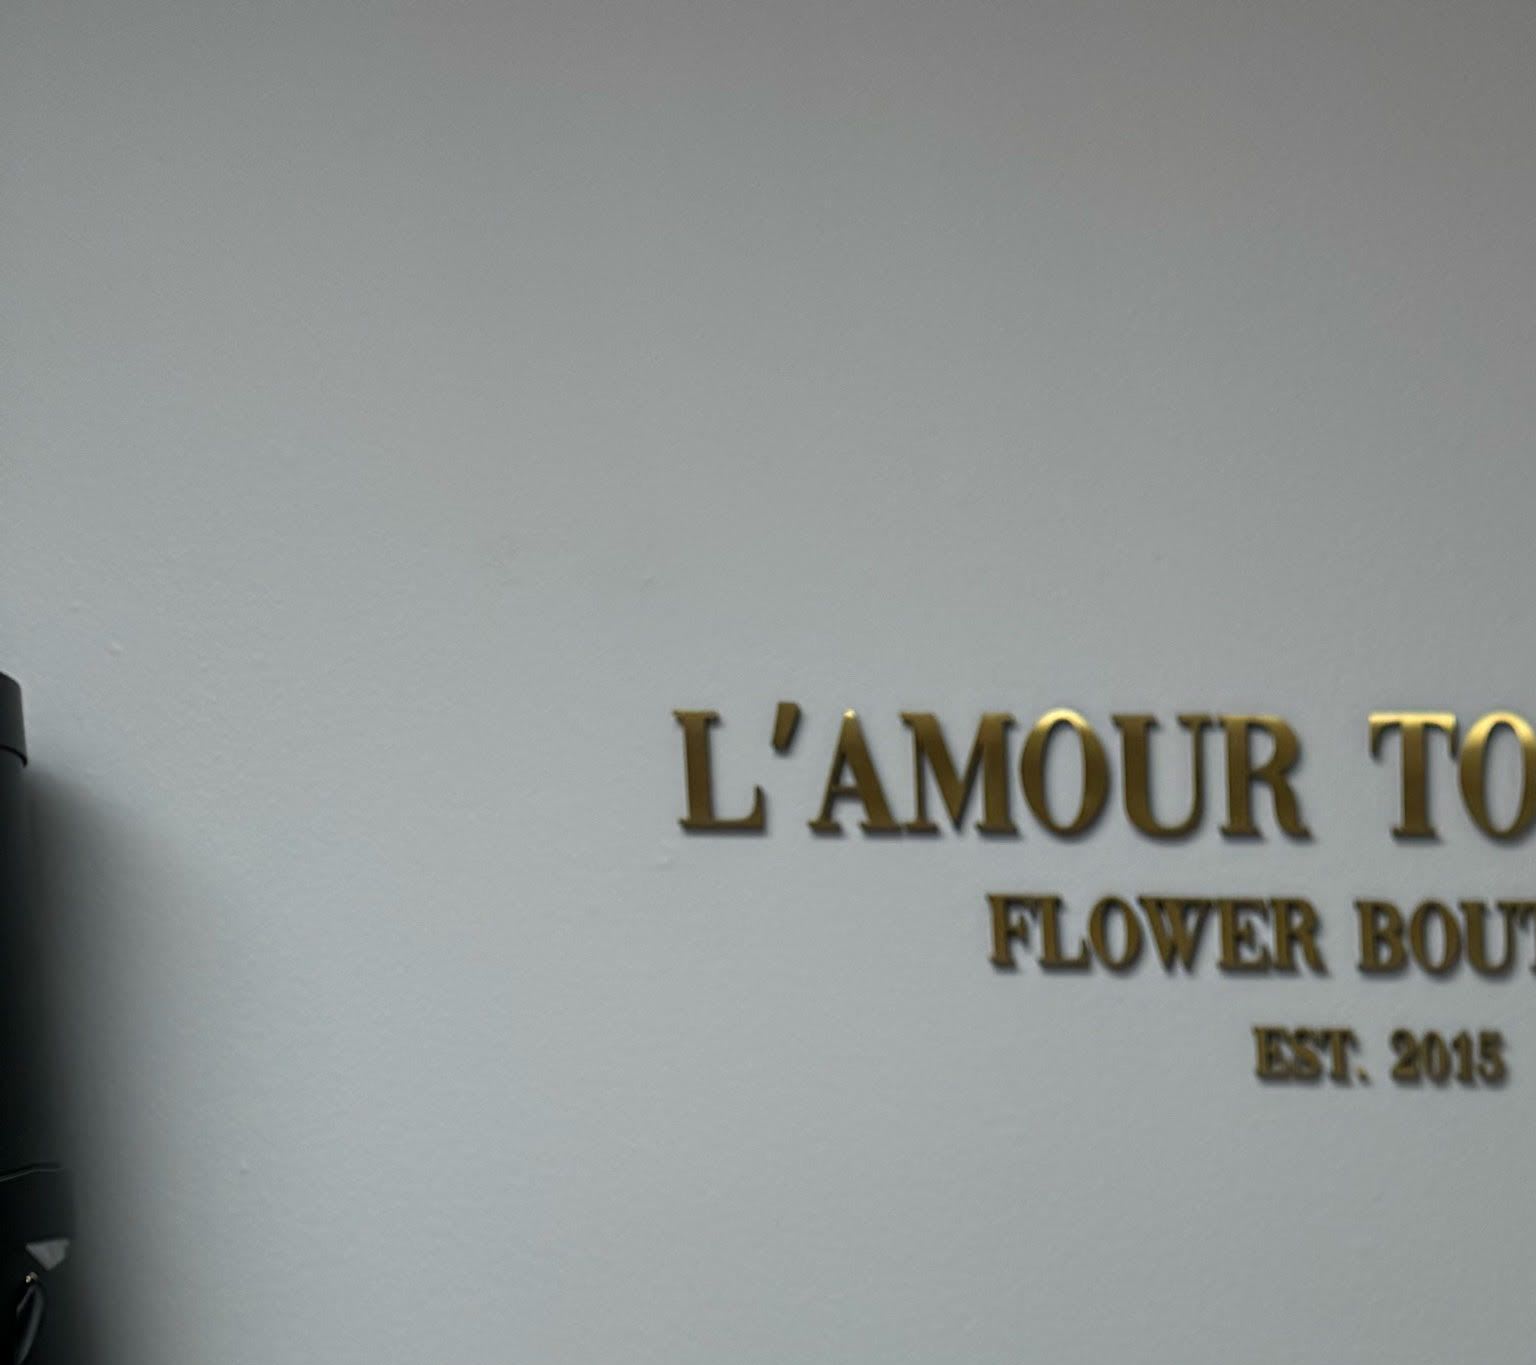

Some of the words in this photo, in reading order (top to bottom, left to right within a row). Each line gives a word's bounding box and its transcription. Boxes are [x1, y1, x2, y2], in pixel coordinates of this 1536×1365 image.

[674, 704, 1314, 840] L'AMOUR
[986, 892, 1328, 977] FLOWER
[1251, 1025, 1370, 1086] EST.
[1390, 1025, 1508, 1086] 2015
